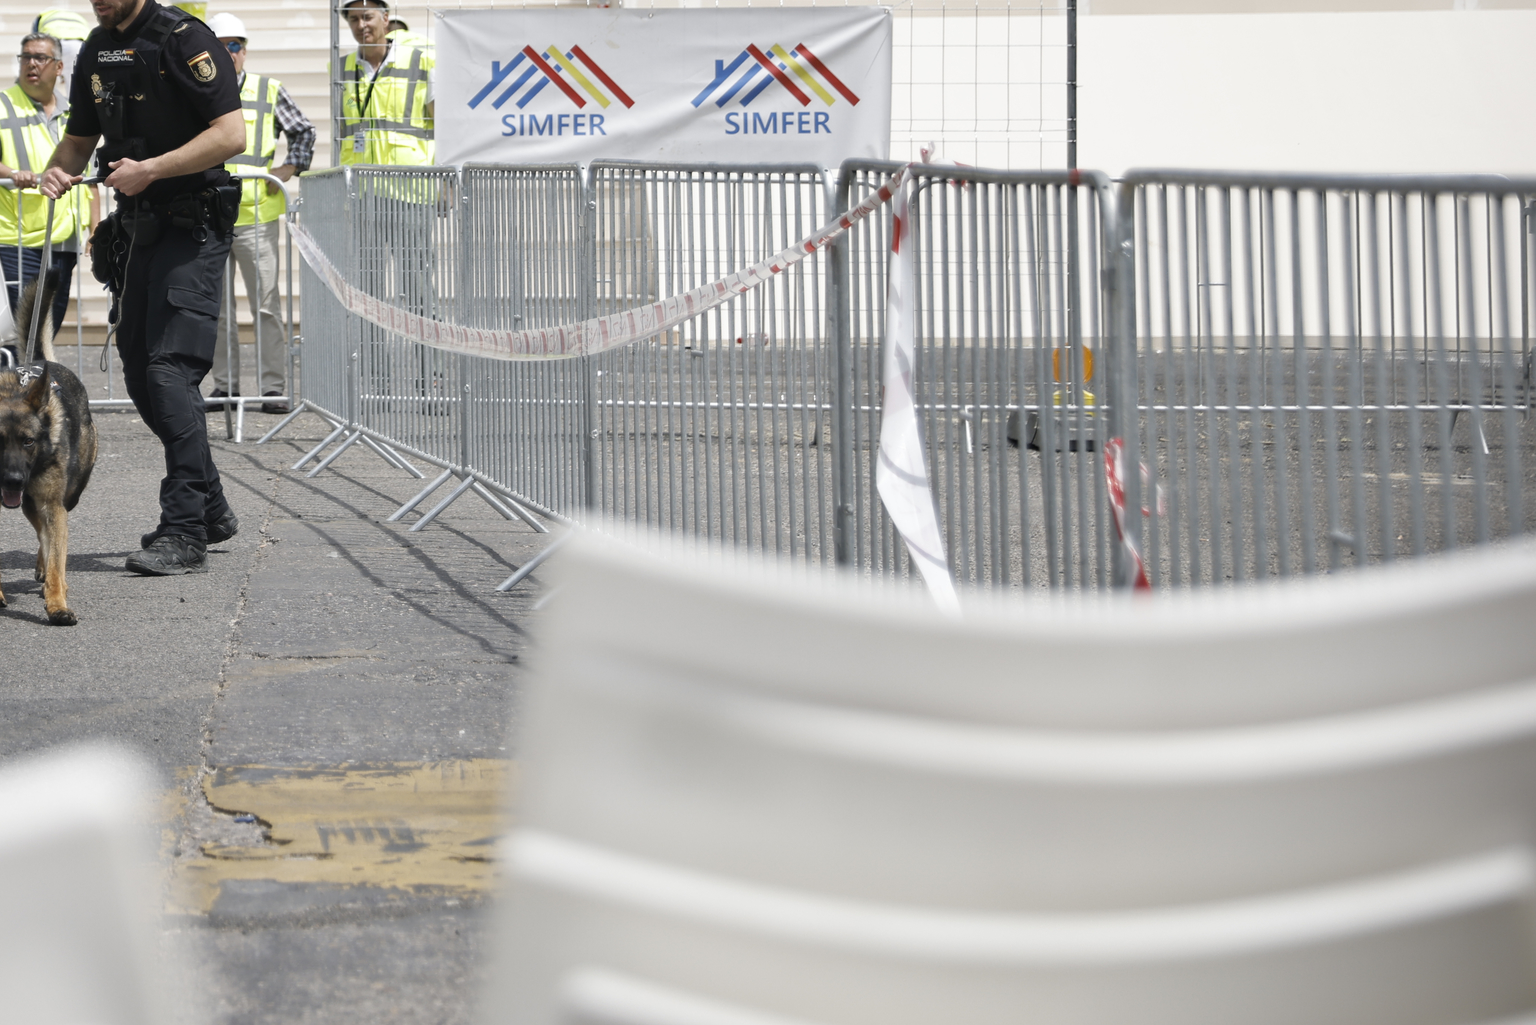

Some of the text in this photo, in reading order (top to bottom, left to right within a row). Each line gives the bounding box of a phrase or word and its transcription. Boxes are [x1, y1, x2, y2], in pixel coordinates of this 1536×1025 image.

[98, 55, 134, 63] NACIONAL
[501, 114, 606, 136] SIMFER
[725, 112, 831, 134] SIMFER
